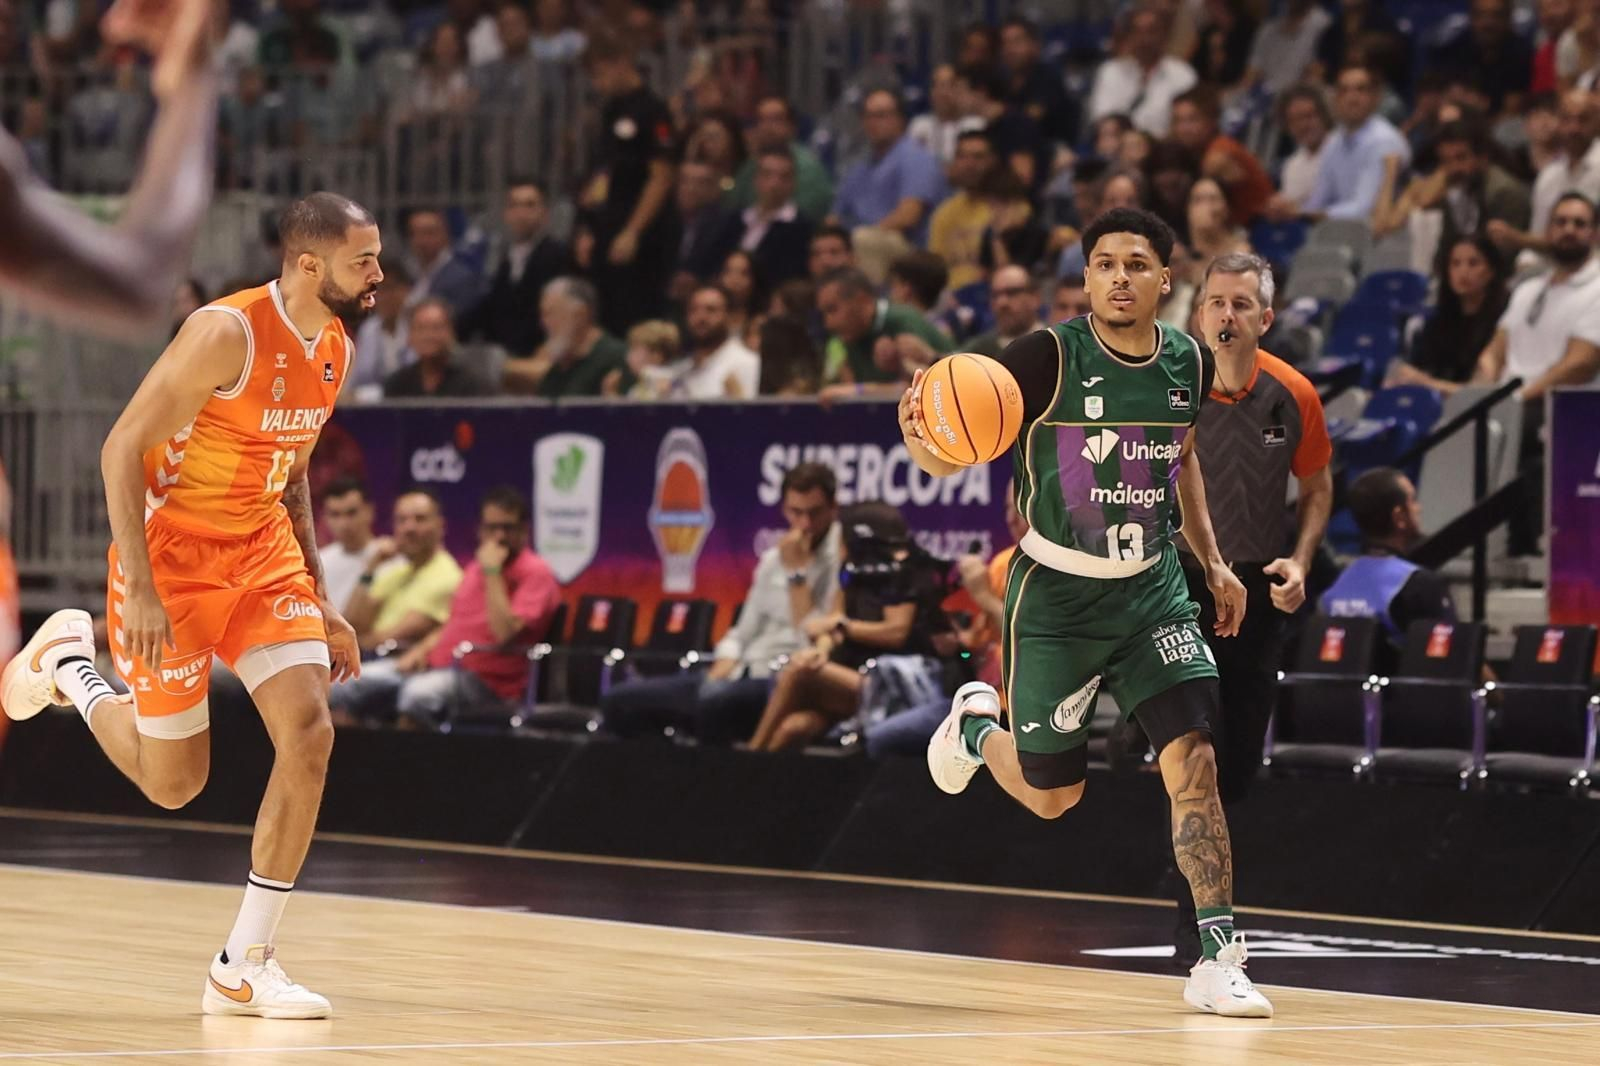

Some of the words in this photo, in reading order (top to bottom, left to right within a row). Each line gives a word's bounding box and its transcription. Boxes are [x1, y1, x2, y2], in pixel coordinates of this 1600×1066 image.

[933, 381, 946, 424] endesa
[942, 425, 958, 445] liga
[1090, 482, 1165, 508] málaga
[1106, 523, 1145, 561] 13
[1152, 624, 1177, 639] sabor
